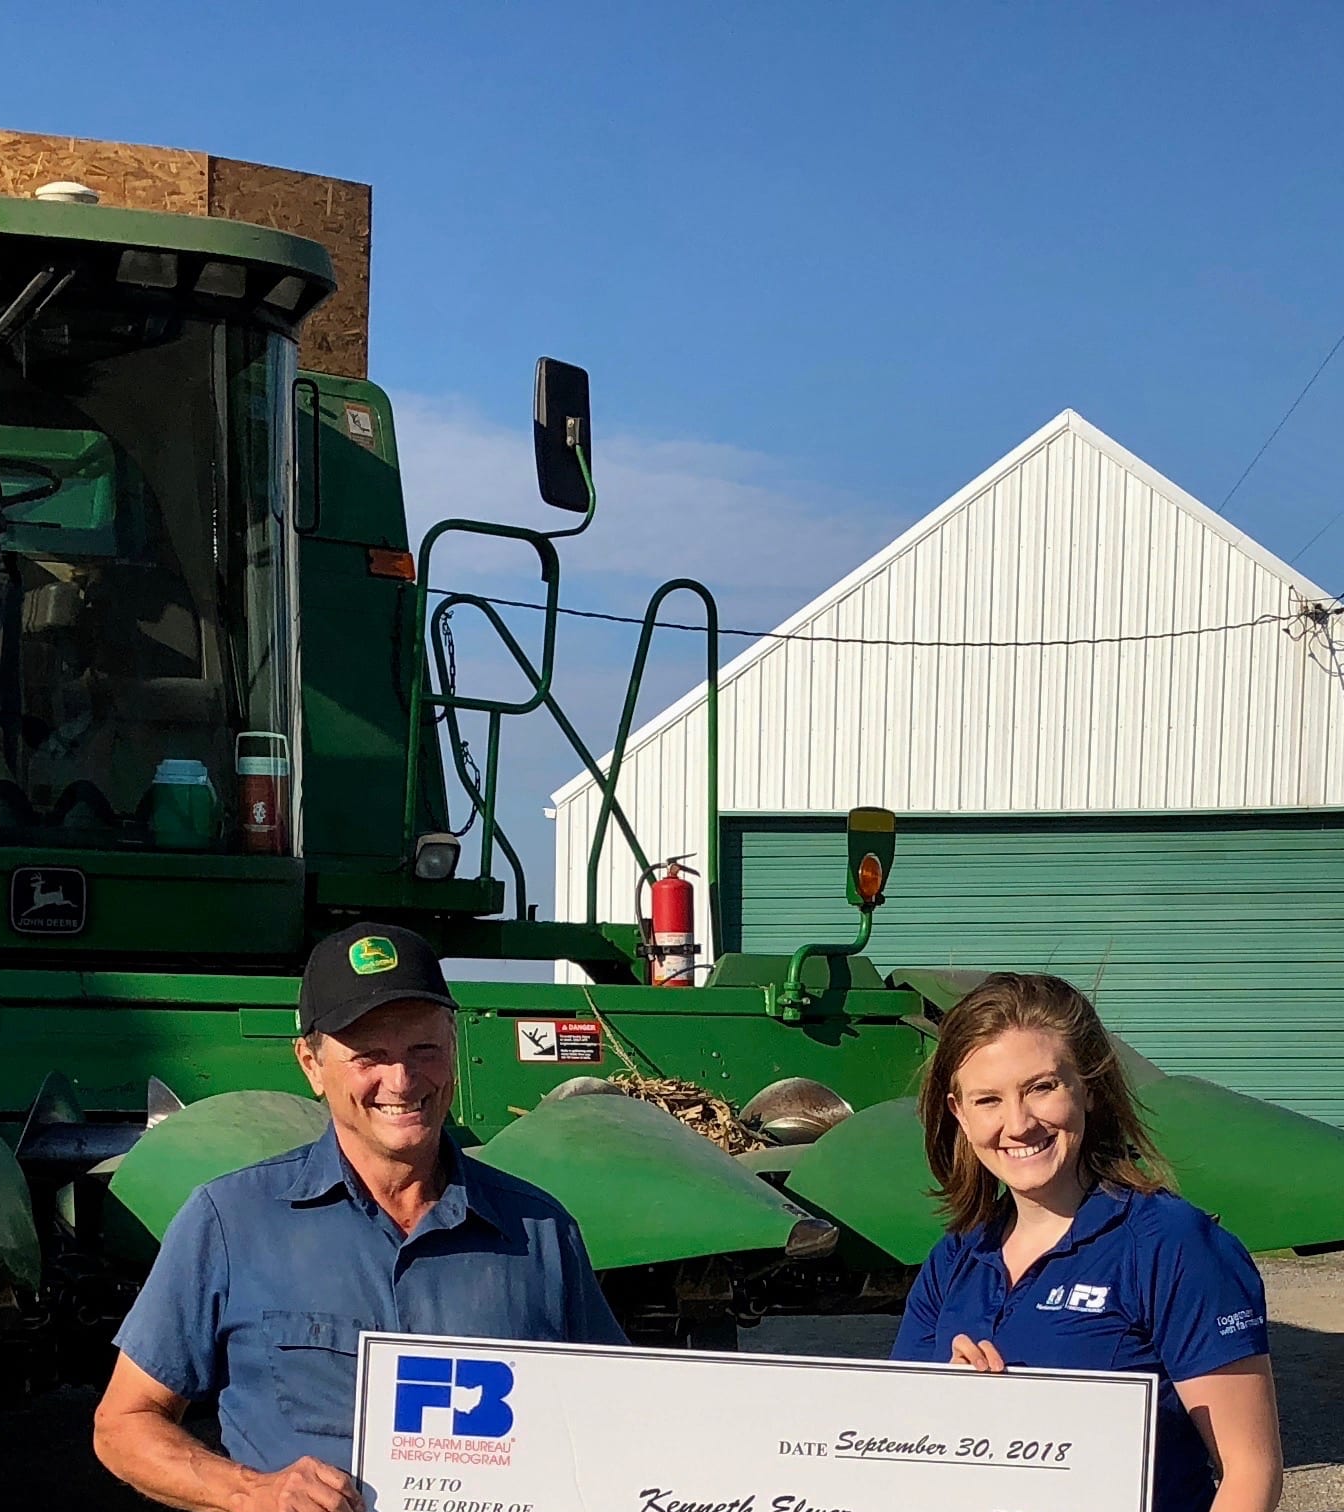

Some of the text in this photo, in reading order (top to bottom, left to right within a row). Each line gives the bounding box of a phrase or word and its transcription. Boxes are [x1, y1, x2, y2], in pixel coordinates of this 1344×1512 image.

[568, 1023, 596, 1031] DANGER
[393, 1355, 515, 1438] FB
[392, 1436, 511, 1453] OHIO FARM BUREAU
[778, 1431, 1072, 1462] DATE September 30, 2018
[391, 1449, 511, 1466] ENERGY PROGRAM
[403, 1477, 461, 1493] PAY TO
[403, 1499, 438, 1512] THE
